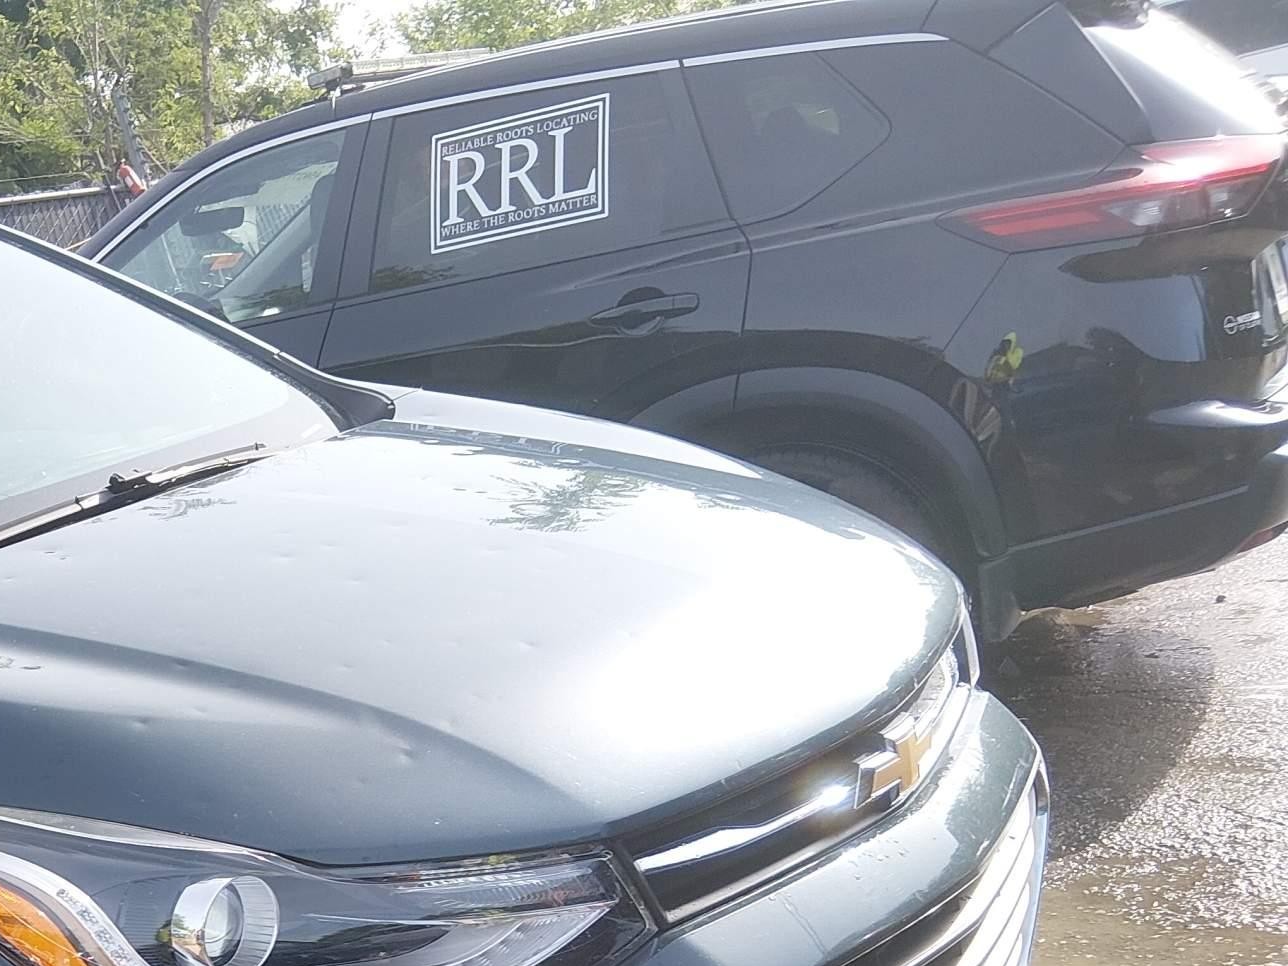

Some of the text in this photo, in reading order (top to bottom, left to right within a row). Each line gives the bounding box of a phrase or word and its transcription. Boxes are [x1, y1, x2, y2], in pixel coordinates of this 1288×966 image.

[441, 110, 598, 156] RELIABLE ROOTS LOCATING
[441, 126, 596, 226] RRL
[440, 194, 598, 237] WHERE THE ROOTS MATTER
